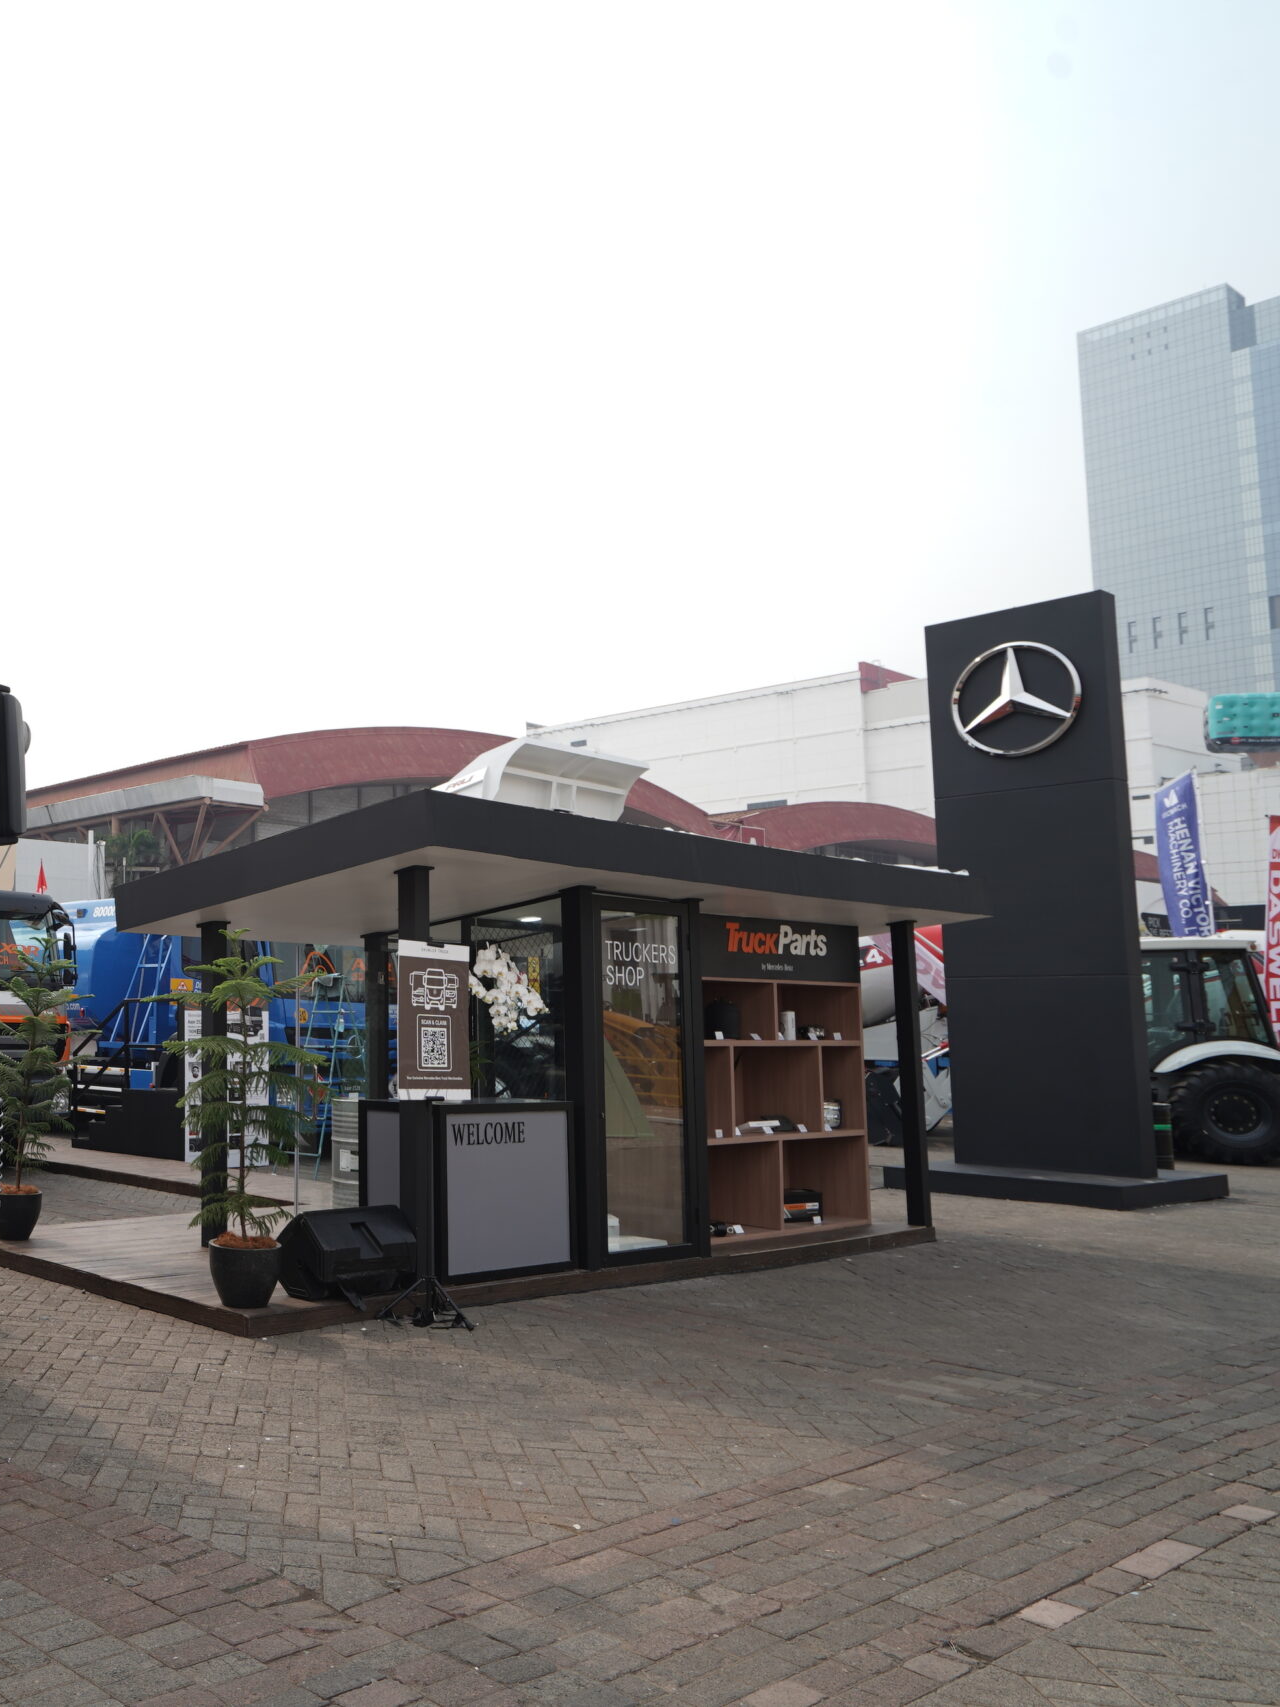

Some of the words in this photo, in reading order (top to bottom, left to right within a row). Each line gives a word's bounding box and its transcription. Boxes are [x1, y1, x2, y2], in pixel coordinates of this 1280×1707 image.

[1168, 821, 1189, 896] MACHINERY
[1173, 816, 1200, 875] HENAN
[605, 940, 676, 965] TRUCKERS
[726, 922, 827, 957] TruckParts
[606, 965, 645, 986] SHOP
[451, 1121, 526, 1147] WELCOME
